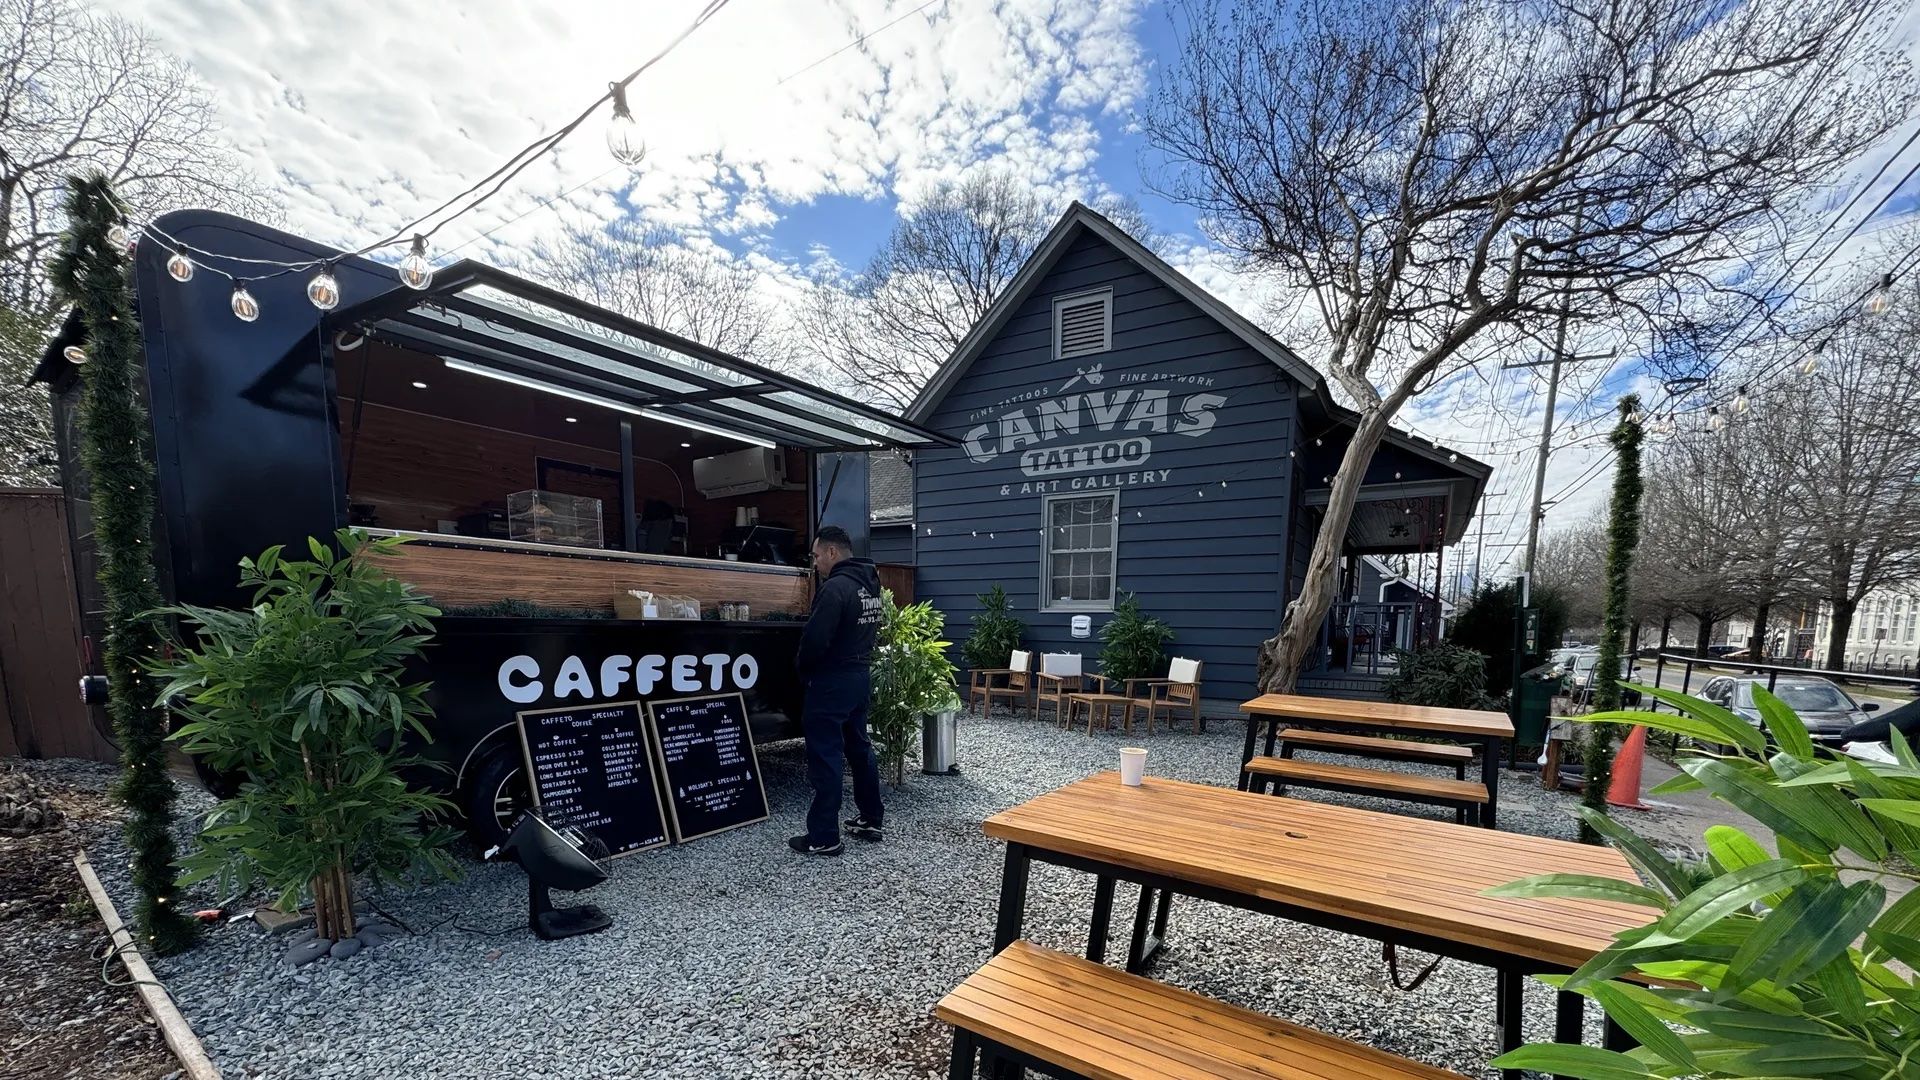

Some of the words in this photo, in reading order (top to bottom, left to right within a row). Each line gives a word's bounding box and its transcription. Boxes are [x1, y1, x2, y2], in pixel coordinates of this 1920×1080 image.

[1119, 373, 1147, 383] FINE
[1151, 373, 1215, 387] ARTWORK
[969, 407, 994, 422] FINE
[997, 387, 1049, 409] TATTOOS
[960, 389, 1228, 465] CANVAS
[1027, 439, 1143, 472] TATTOO
[1000, 484, 1011, 496] &
[1020, 480, 1060, 495] ART
[1071, 469, 1173, 490] GALLERY
[498, 653, 759, 703] CAFFETO
[592, 710, 624, 720] SPECIALTY
[541, 716, 573, 725] CAFFETO
[571, 720, 593, 728] COFFEE
[678, 723, 695, 731] COFFEE
[672, 733, 695, 741] CHOCOLATE
[553, 739, 577, 747] COFFEE
[536, 752, 566, 762] ESPRESSO
[554, 761, 568, 769] OVER
[605, 764, 633, 773] SHAKERATO
[541, 780, 567, 789] CORTADO
[608, 779, 631, 788] AFFOGATO
[688, 781, 713, 791] HOLIDAY'S
[717, 775, 741, 785] SPECIALS
[543, 788, 573, 799] CAPPUCCINO
[705, 791, 725, 800] NAUGHTY
[583, 820, 600, 828] LATTE
